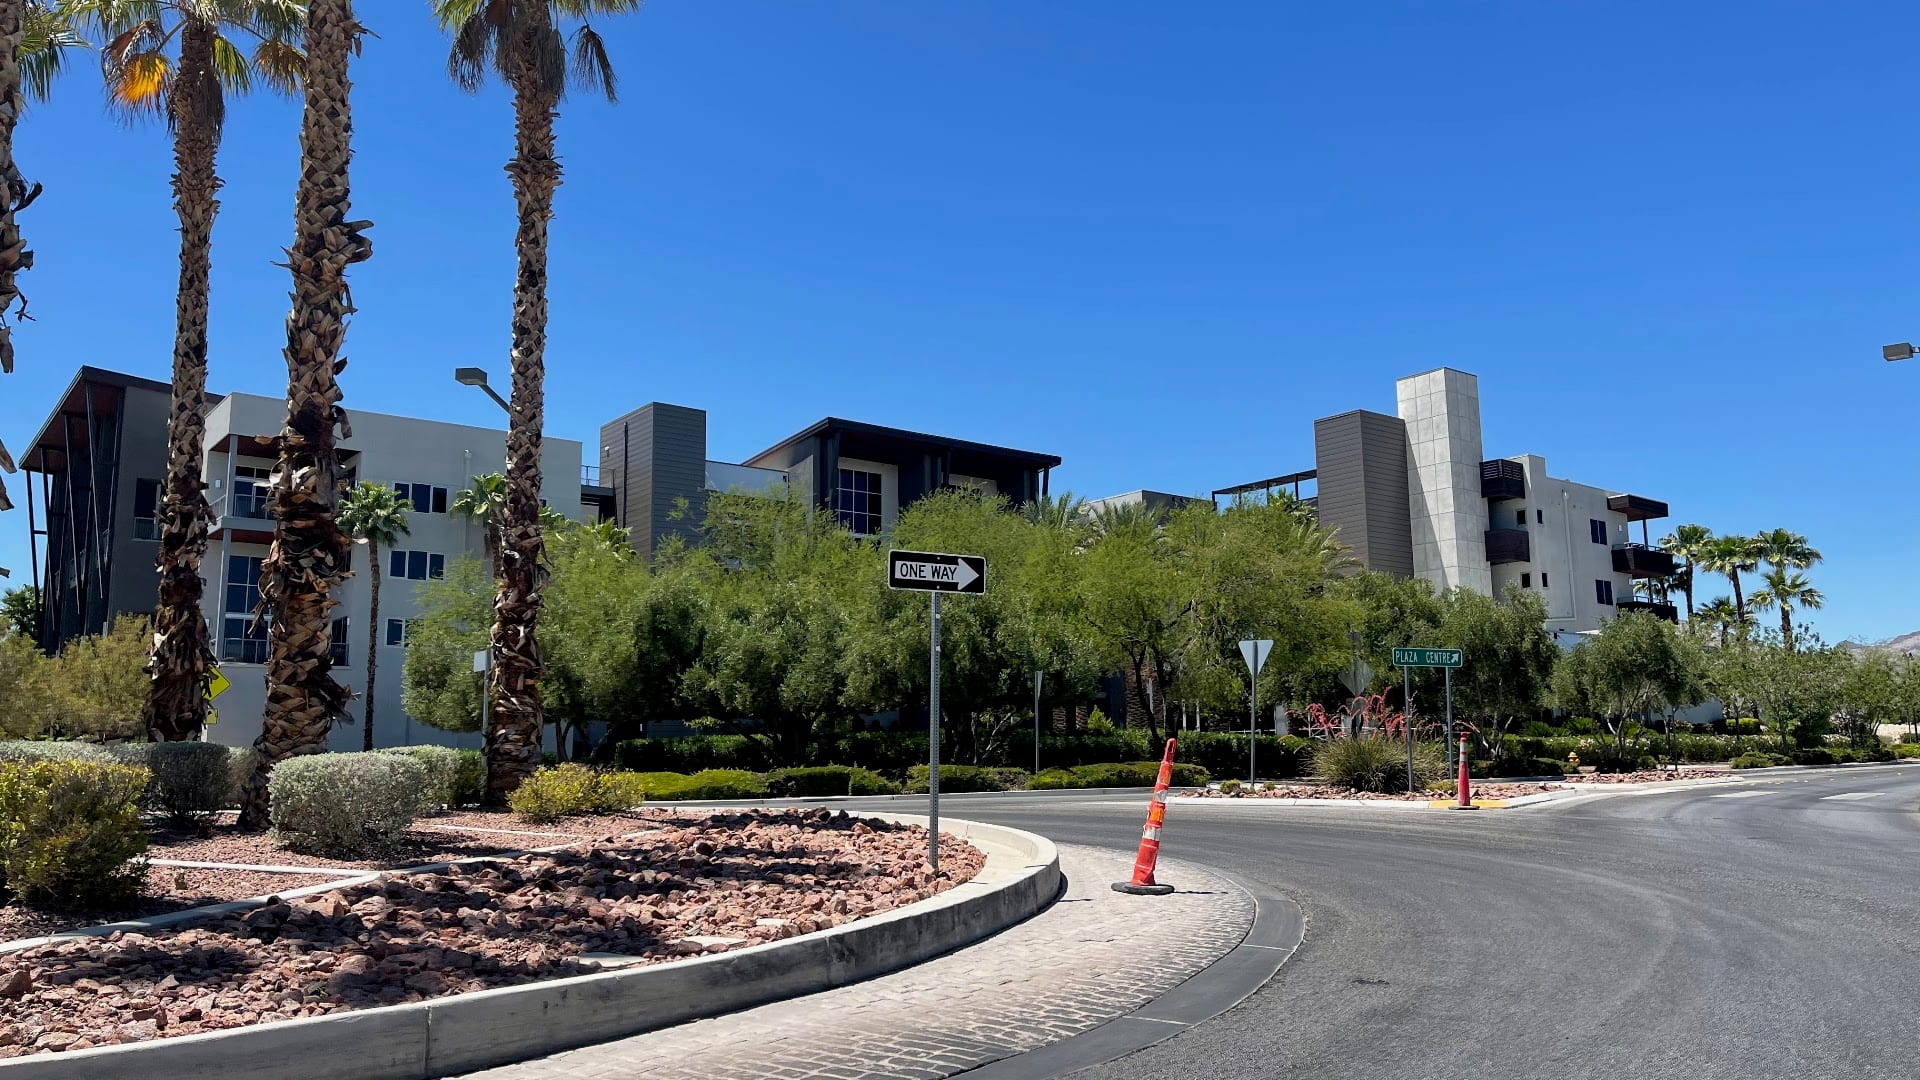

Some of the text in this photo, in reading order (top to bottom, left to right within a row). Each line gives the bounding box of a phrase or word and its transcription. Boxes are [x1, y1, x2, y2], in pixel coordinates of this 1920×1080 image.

[900, 562, 957, 580] ONE WAY
[1395, 650, 1451, 664] PLAZA CENTRE
